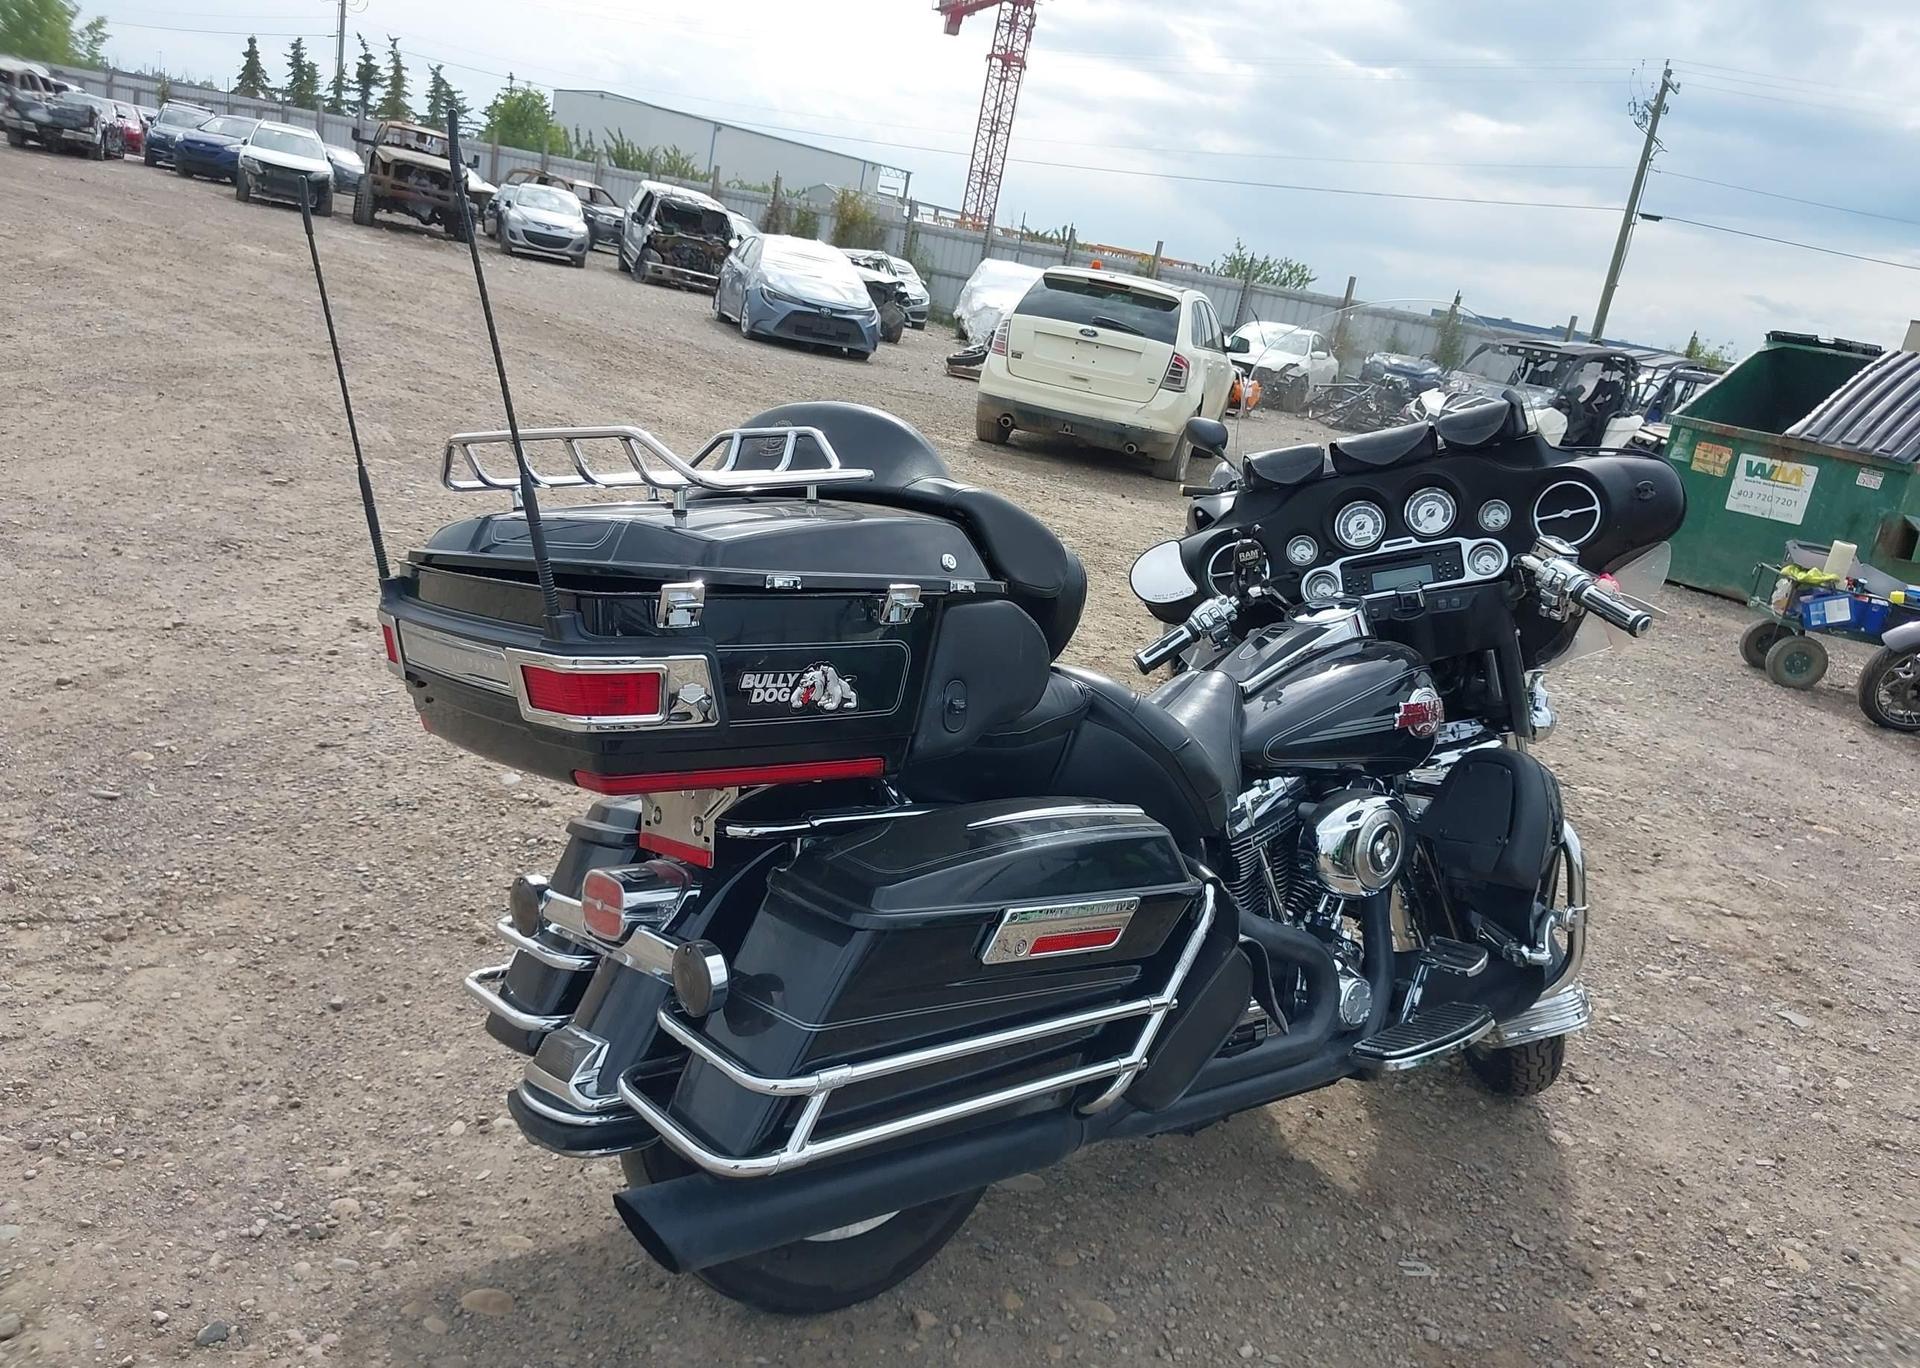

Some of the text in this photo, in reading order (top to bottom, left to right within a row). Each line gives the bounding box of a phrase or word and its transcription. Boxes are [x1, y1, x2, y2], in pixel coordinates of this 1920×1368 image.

[1745, 460, 1803, 487] WM
[1737, 489, 1798, 508] 403 720 7201
[1239, 549, 1260, 560] RAM
[741, 673, 800, 688] BULLY
[751, 688, 790, 703] DOG
